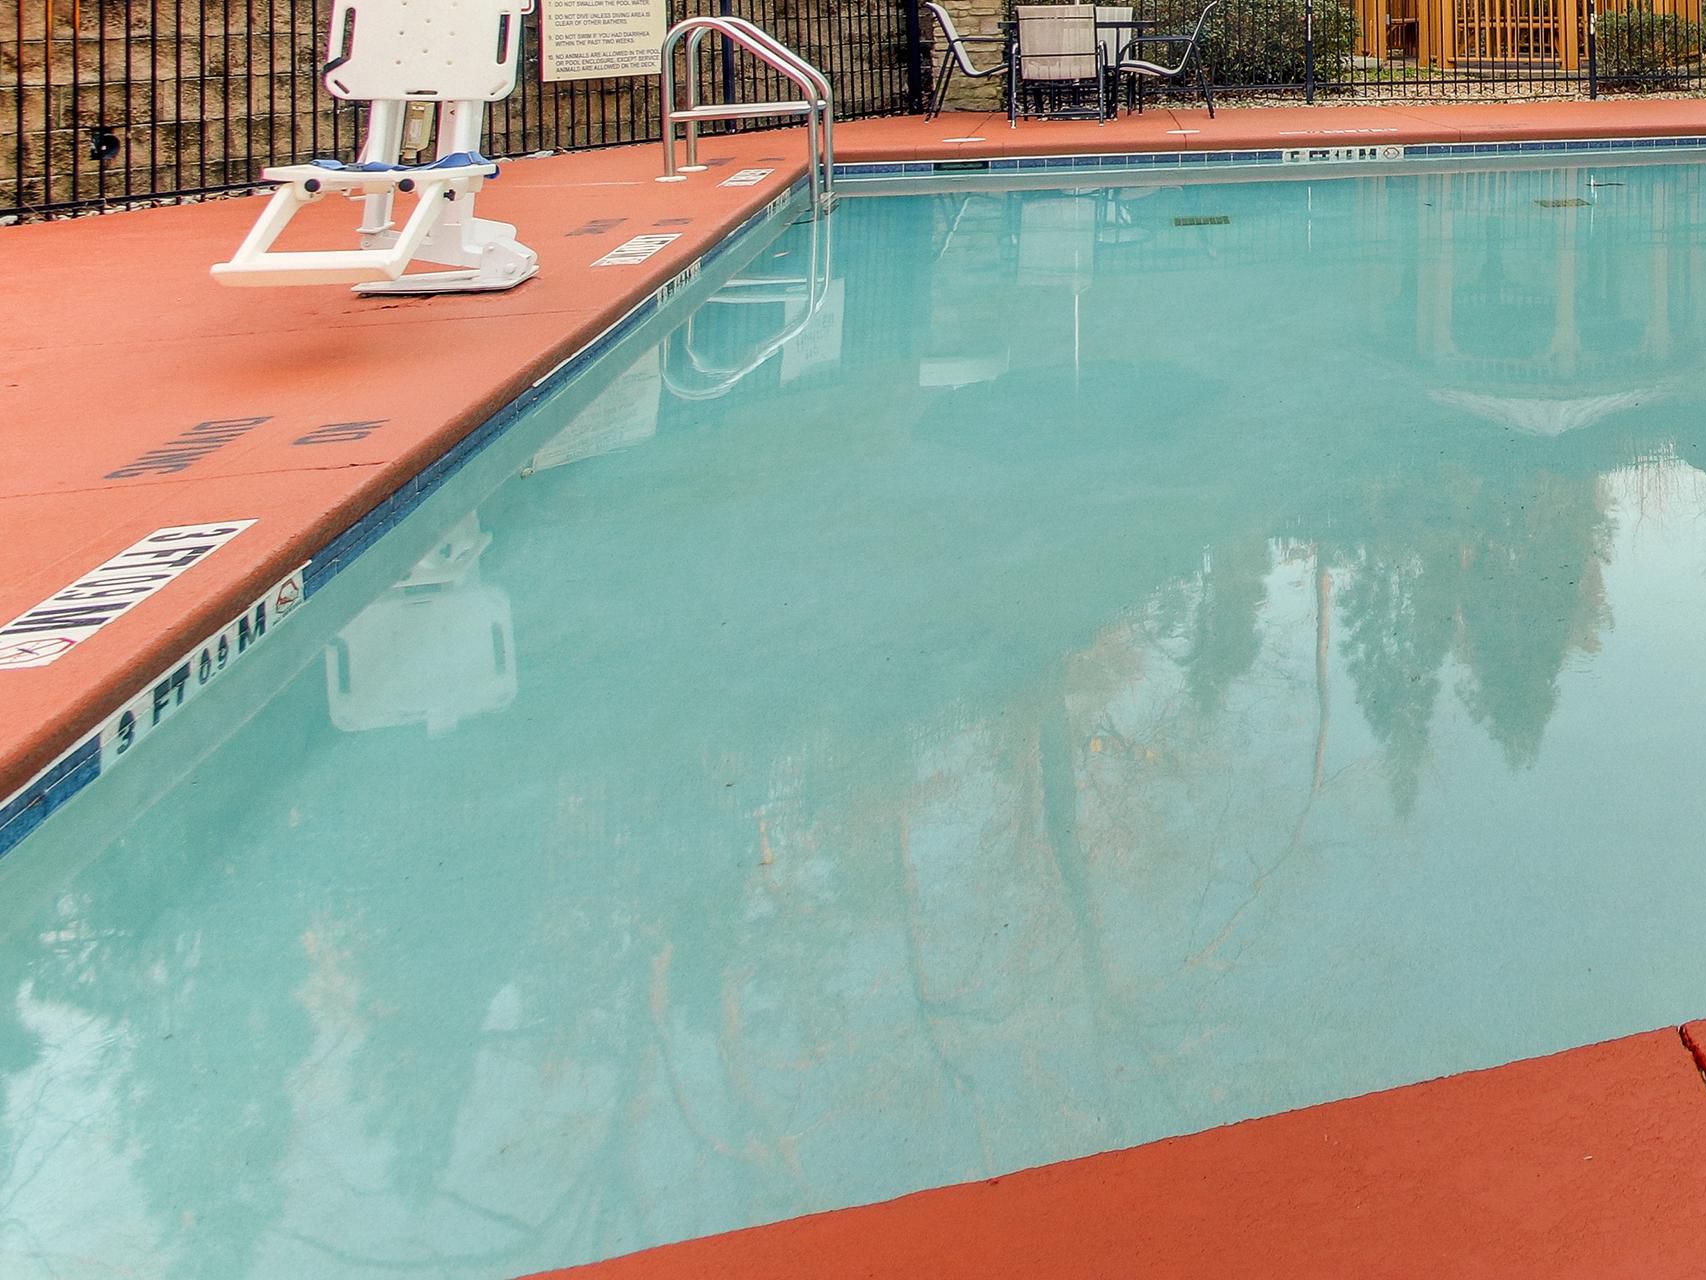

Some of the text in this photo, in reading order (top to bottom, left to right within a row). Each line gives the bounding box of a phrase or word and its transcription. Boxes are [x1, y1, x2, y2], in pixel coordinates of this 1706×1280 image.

[103, 415, 275, 479] DIVING
[292, 418, 391, 446] NO
[148, 527, 239, 542] 3
[99, 544, 216, 571] FT
[0, 601, 134, 635] M
[152, 661, 190, 727] FT
[238, 601, 266, 655] M
